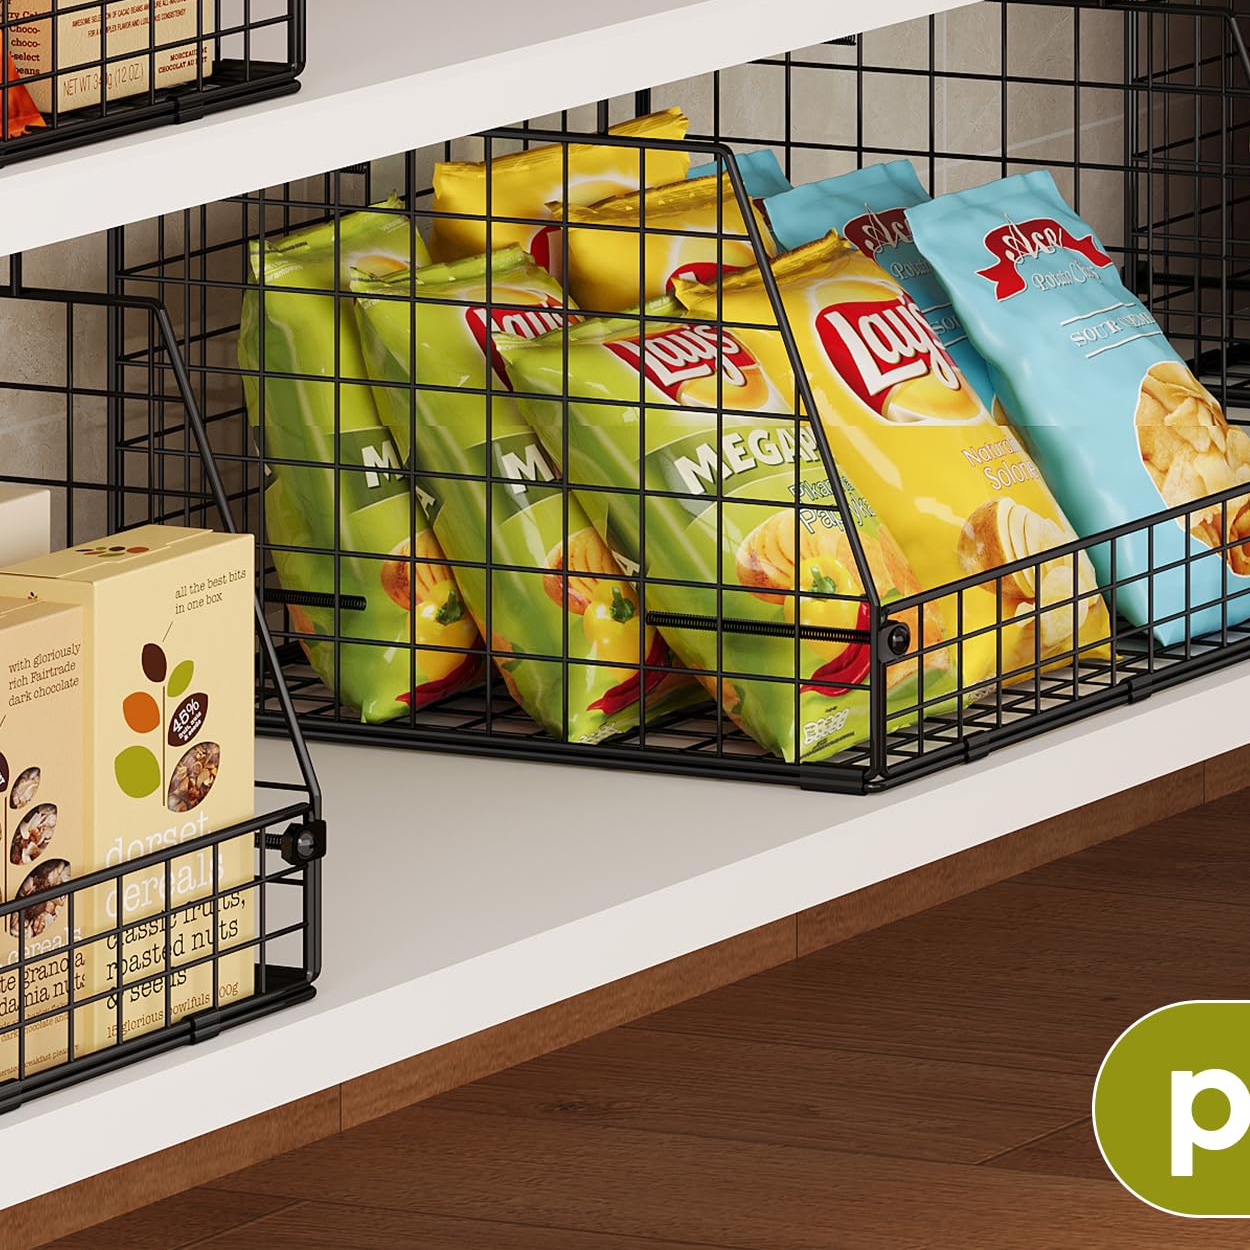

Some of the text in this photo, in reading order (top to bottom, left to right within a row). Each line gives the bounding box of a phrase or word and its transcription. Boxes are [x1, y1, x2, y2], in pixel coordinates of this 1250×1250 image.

[11, 38, 40, 47] choco-
[170, 49, 198, 62] MORCEAU
[158, 59, 194, 74] CHOCOLAT AU
[63, 78, 77, 96] NET
[80, 75, 90, 91] WT
[825, 290, 960, 396] Lay's
[1070, 320, 1123, 347] SOUR
[175, 568, 247, 600] all the best bits
[175, 591, 223, 615] in one box
[8, 642, 81, 674] with gloriously
[8, 661, 76, 691] rich Fairtrade
[8, 676, 79, 707] dark chocolate
[172, 698, 200, 732] 45%
[105, 810, 209, 870] dorset
[105, 850, 225, 918] cereals
[191, 918, 239, 945] nuts
[24, 951, 85, 990] granoa
[167, 992, 210, 1016] owlfuls
[216, 982, 239, 1000] 00g
